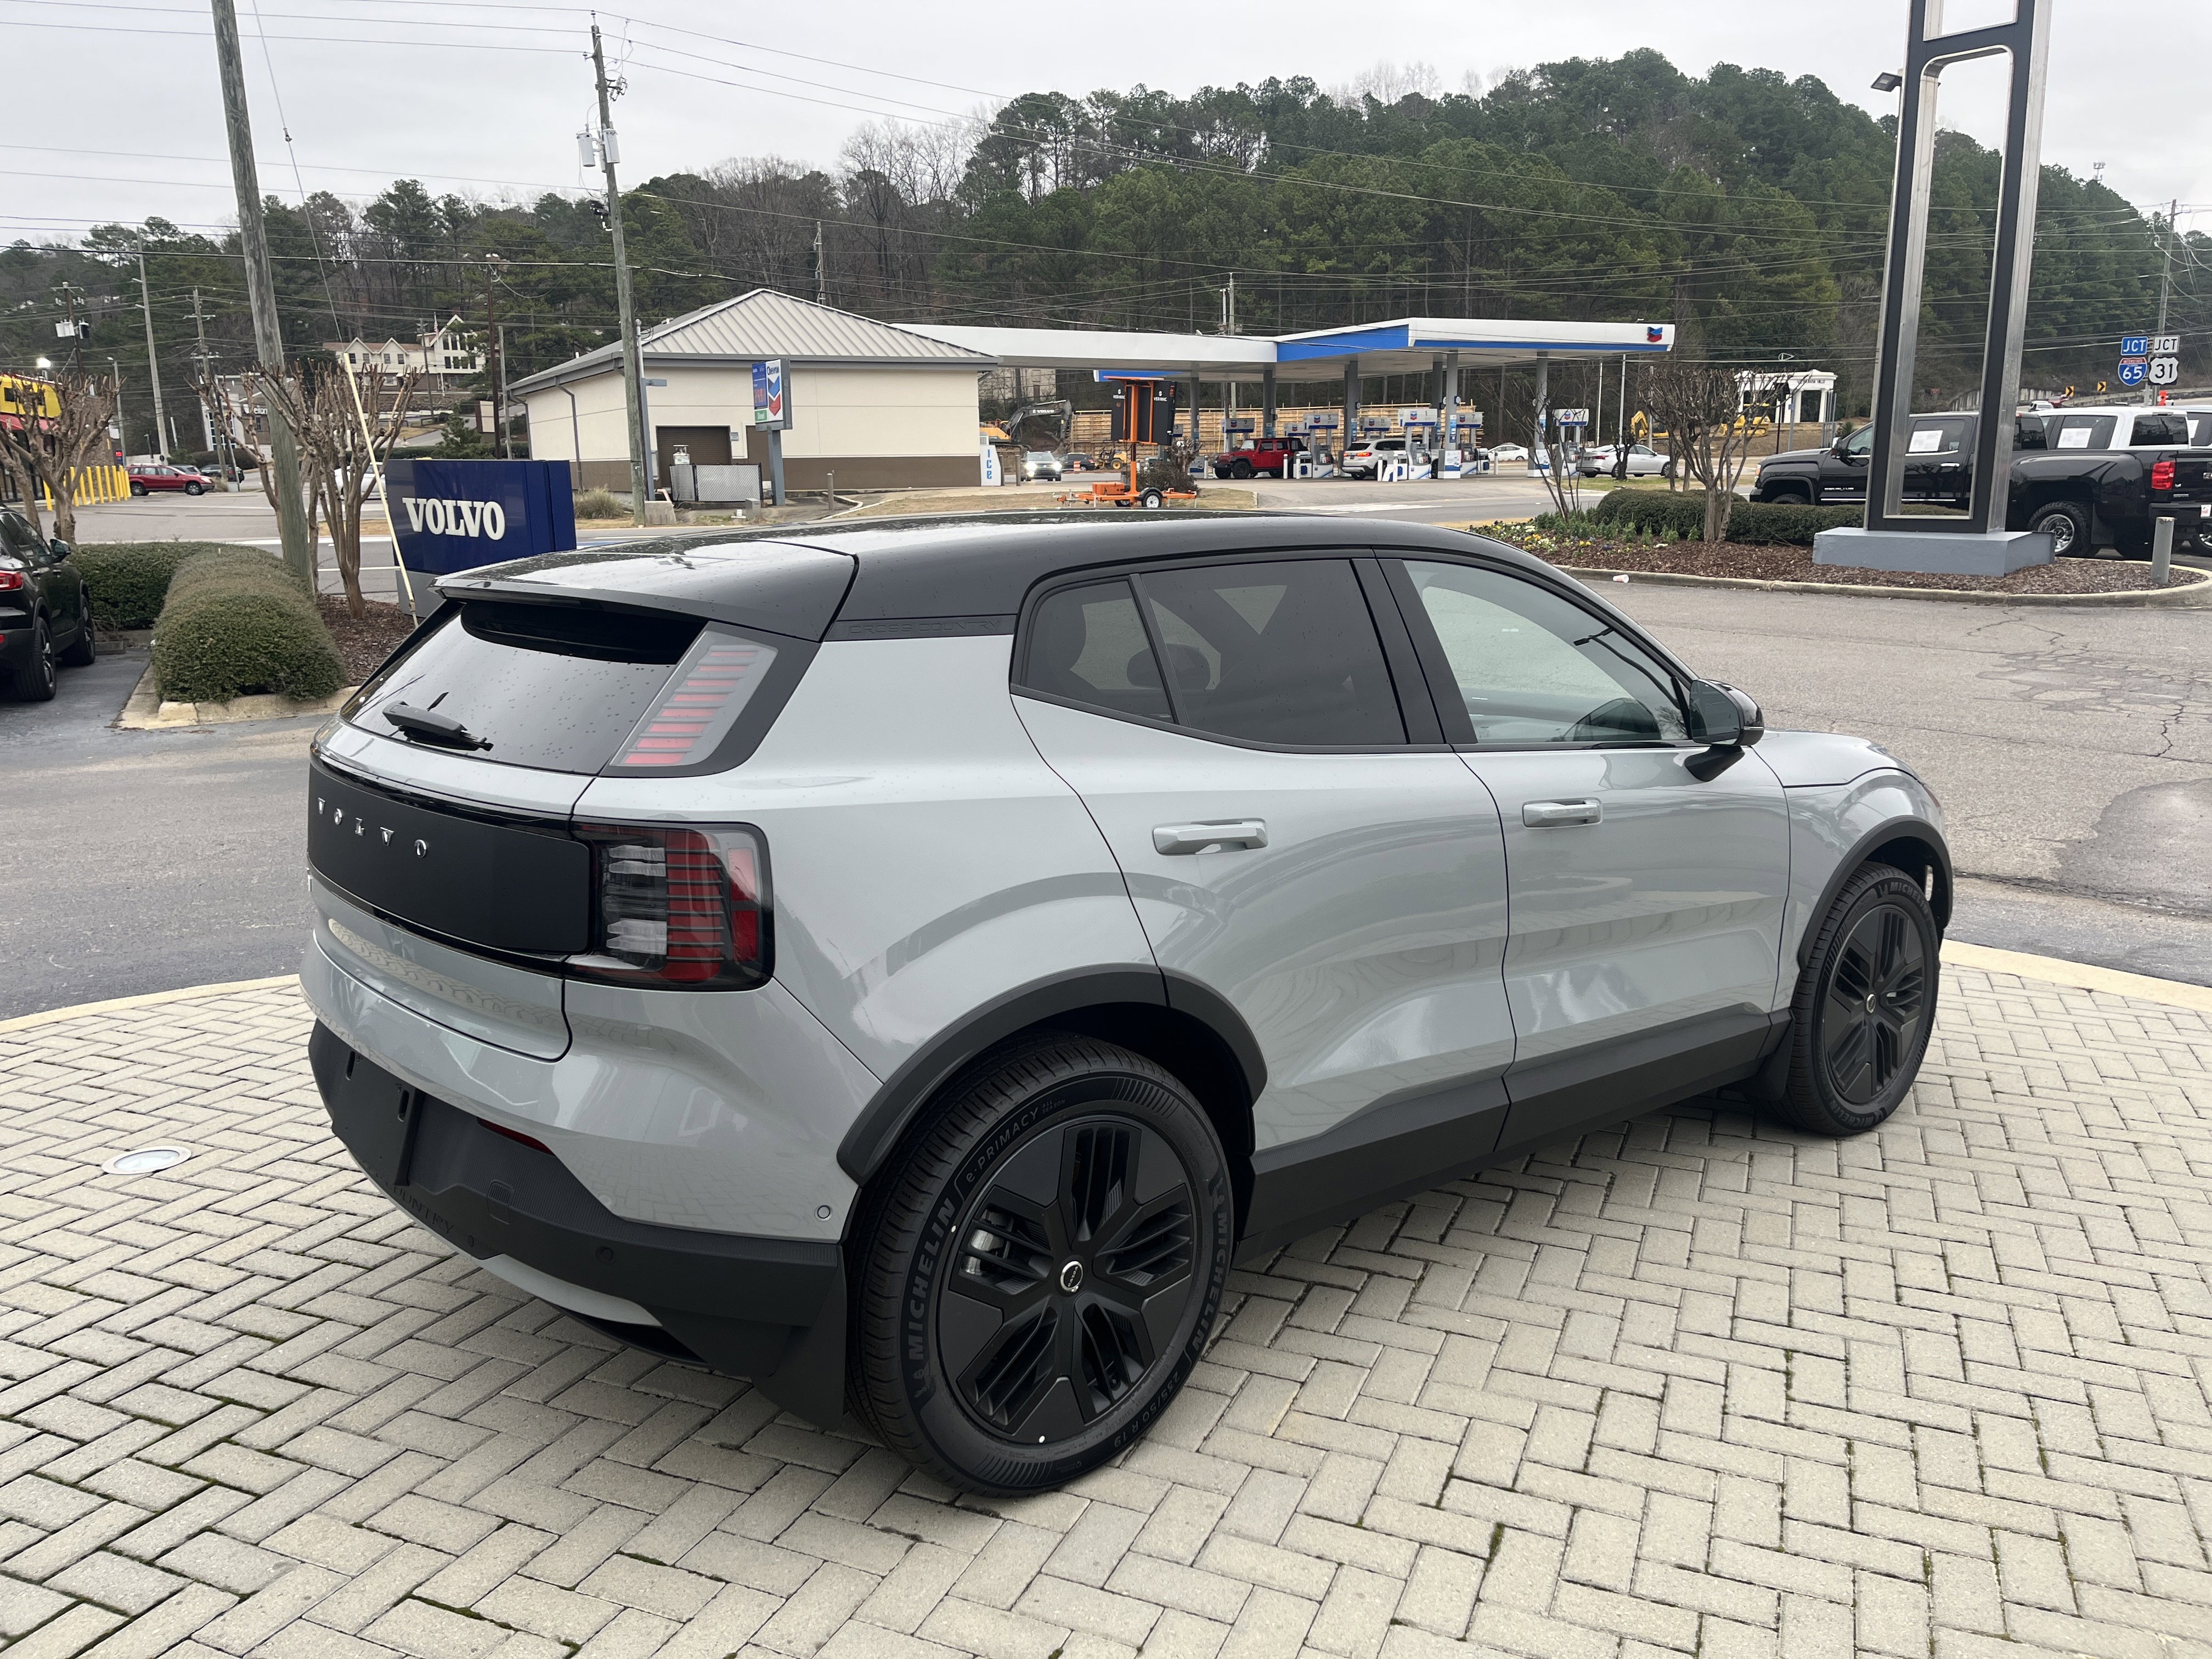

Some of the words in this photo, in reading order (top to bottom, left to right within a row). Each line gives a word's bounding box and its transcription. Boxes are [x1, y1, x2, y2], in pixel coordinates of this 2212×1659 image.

[2123, 340, 2146, 352] JCT
[2154, 338, 2177, 351] JCT
[2122, 366, 2143, 380] 65
[2154, 363, 2173, 379] 31
[402, 497, 506, 540] VOLVO
[318, 797, 427, 858] VOLVO
[1889, 881, 1929, 915] MICHELIN
[1041, 1100, 1053, 1108] ALL
[1042, 1099, 1066, 1115] SEASON
[1829, 1099, 1874, 1127] MICHELIN
[907, 1197, 956, 1361] MICHELIN
[1192, 1212, 1229, 1352] MICHELIN
[1142, 1370, 1181, 1423] 235/50
[1131, 1420, 1139, 1434] R
[1114, 1431, 1128, 1448] 19
